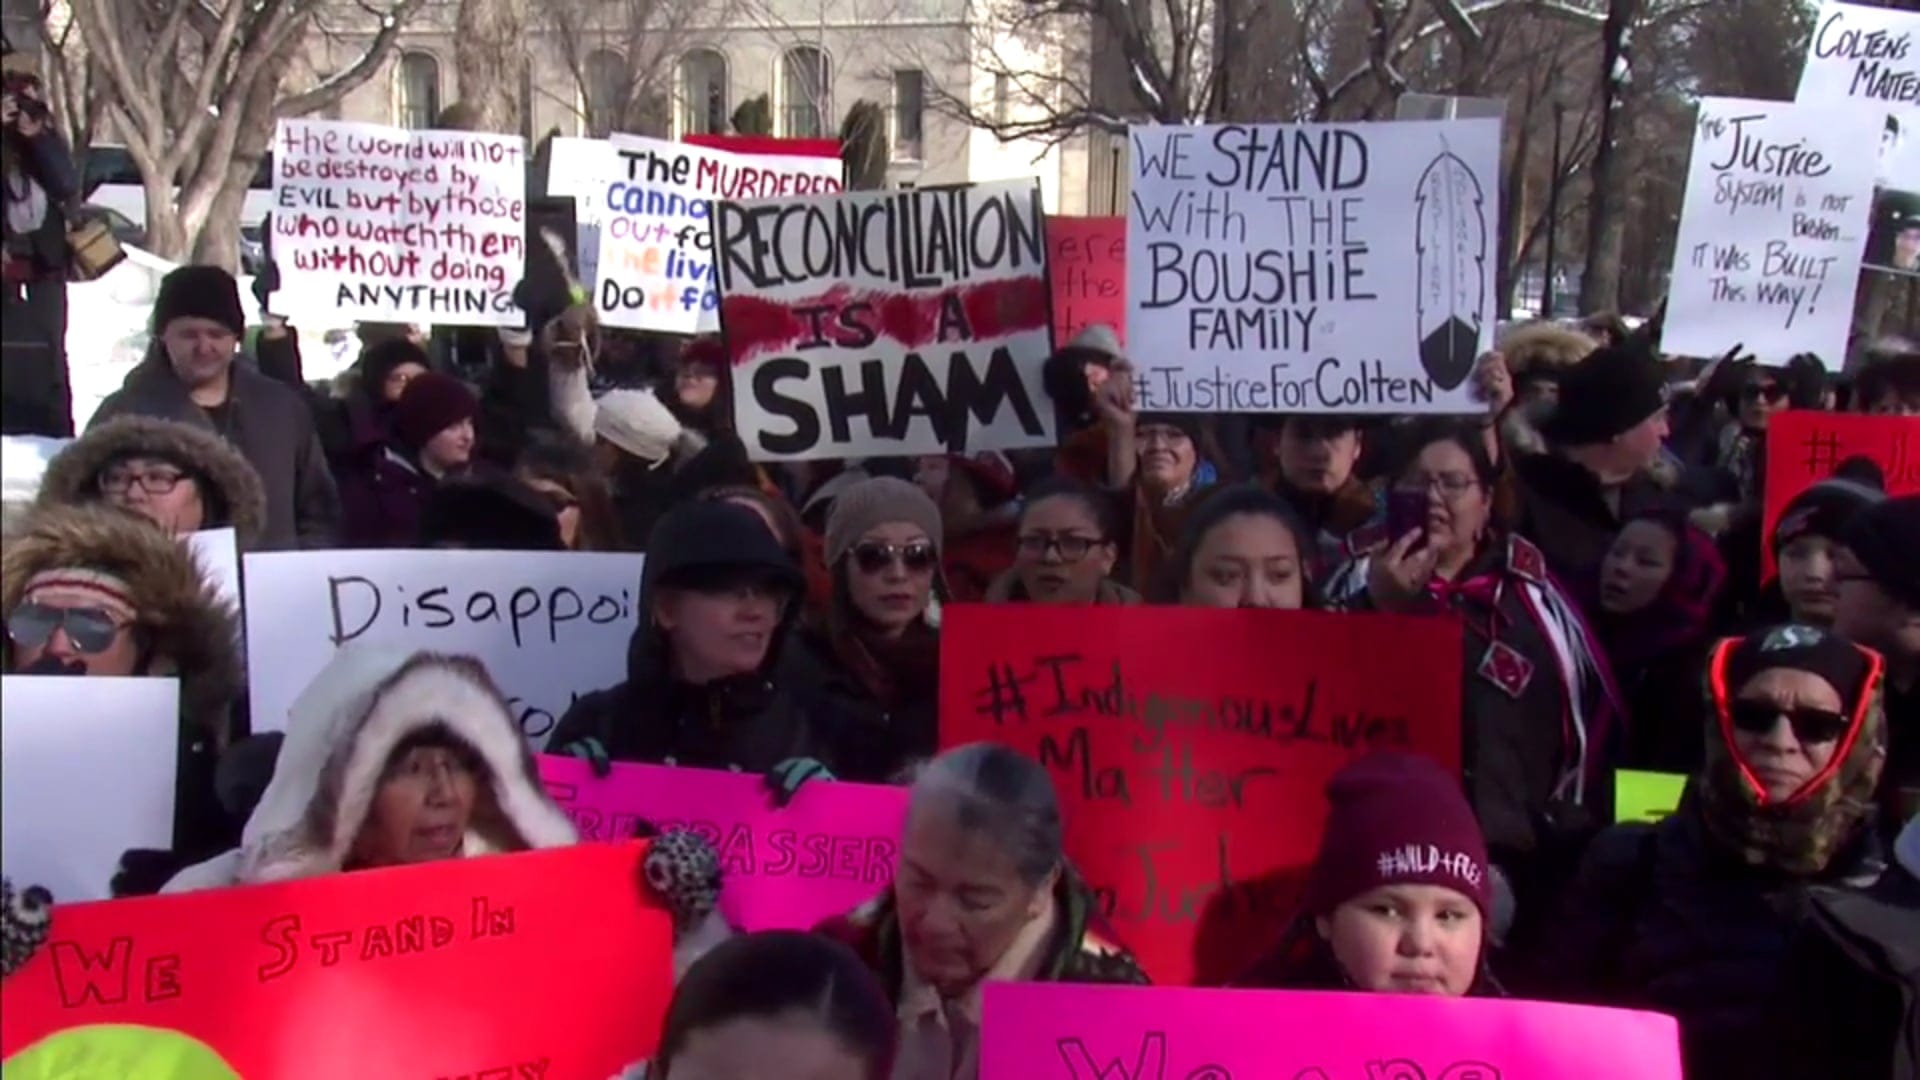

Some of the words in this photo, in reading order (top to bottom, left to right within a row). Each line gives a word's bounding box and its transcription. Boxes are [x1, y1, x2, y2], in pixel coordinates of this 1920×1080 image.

[283, 127, 338, 153] the
[428, 139, 465, 160] will
[472, 139, 521, 168] not
[1133, 132, 1197, 181] WE
[281, 159, 312, 179] be
[317, 158, 438, 191] destroyed
[451, 165, 479, 194] by
[618, 150, 691, 184] The
[695, 156, 842, 198] MURDERED
[279, 186, 341, 209] EVIL
[346, 188, 401, 213] but
[409, 190, 441, 222] by
[446, 186, 522, 222] those
[1267, 195, 1366, 246] THE
[277, 213, 339, 238] who
[346, 220, 438, 250] watch
[440, 224, 523, 260] them
[610, 216, 671, 242] out
[719, 186, 1044, 290] RECONCILIATION
[294, 246, 421, 277] without
[430, 252, 505, 291] doing
[1763, 240, 1838, 281] BUILT
[336, 282, 515, 314] ANYTHING
[602, 278, 644, 312] Do
[793, 303, 877, 350] IS
[937, 292, 973, 343] A
[752, 347, 1045, 456] SHAM
[328, 575, 629, 647] Disappoi
[1039, 726, 1279, 808] Matter
